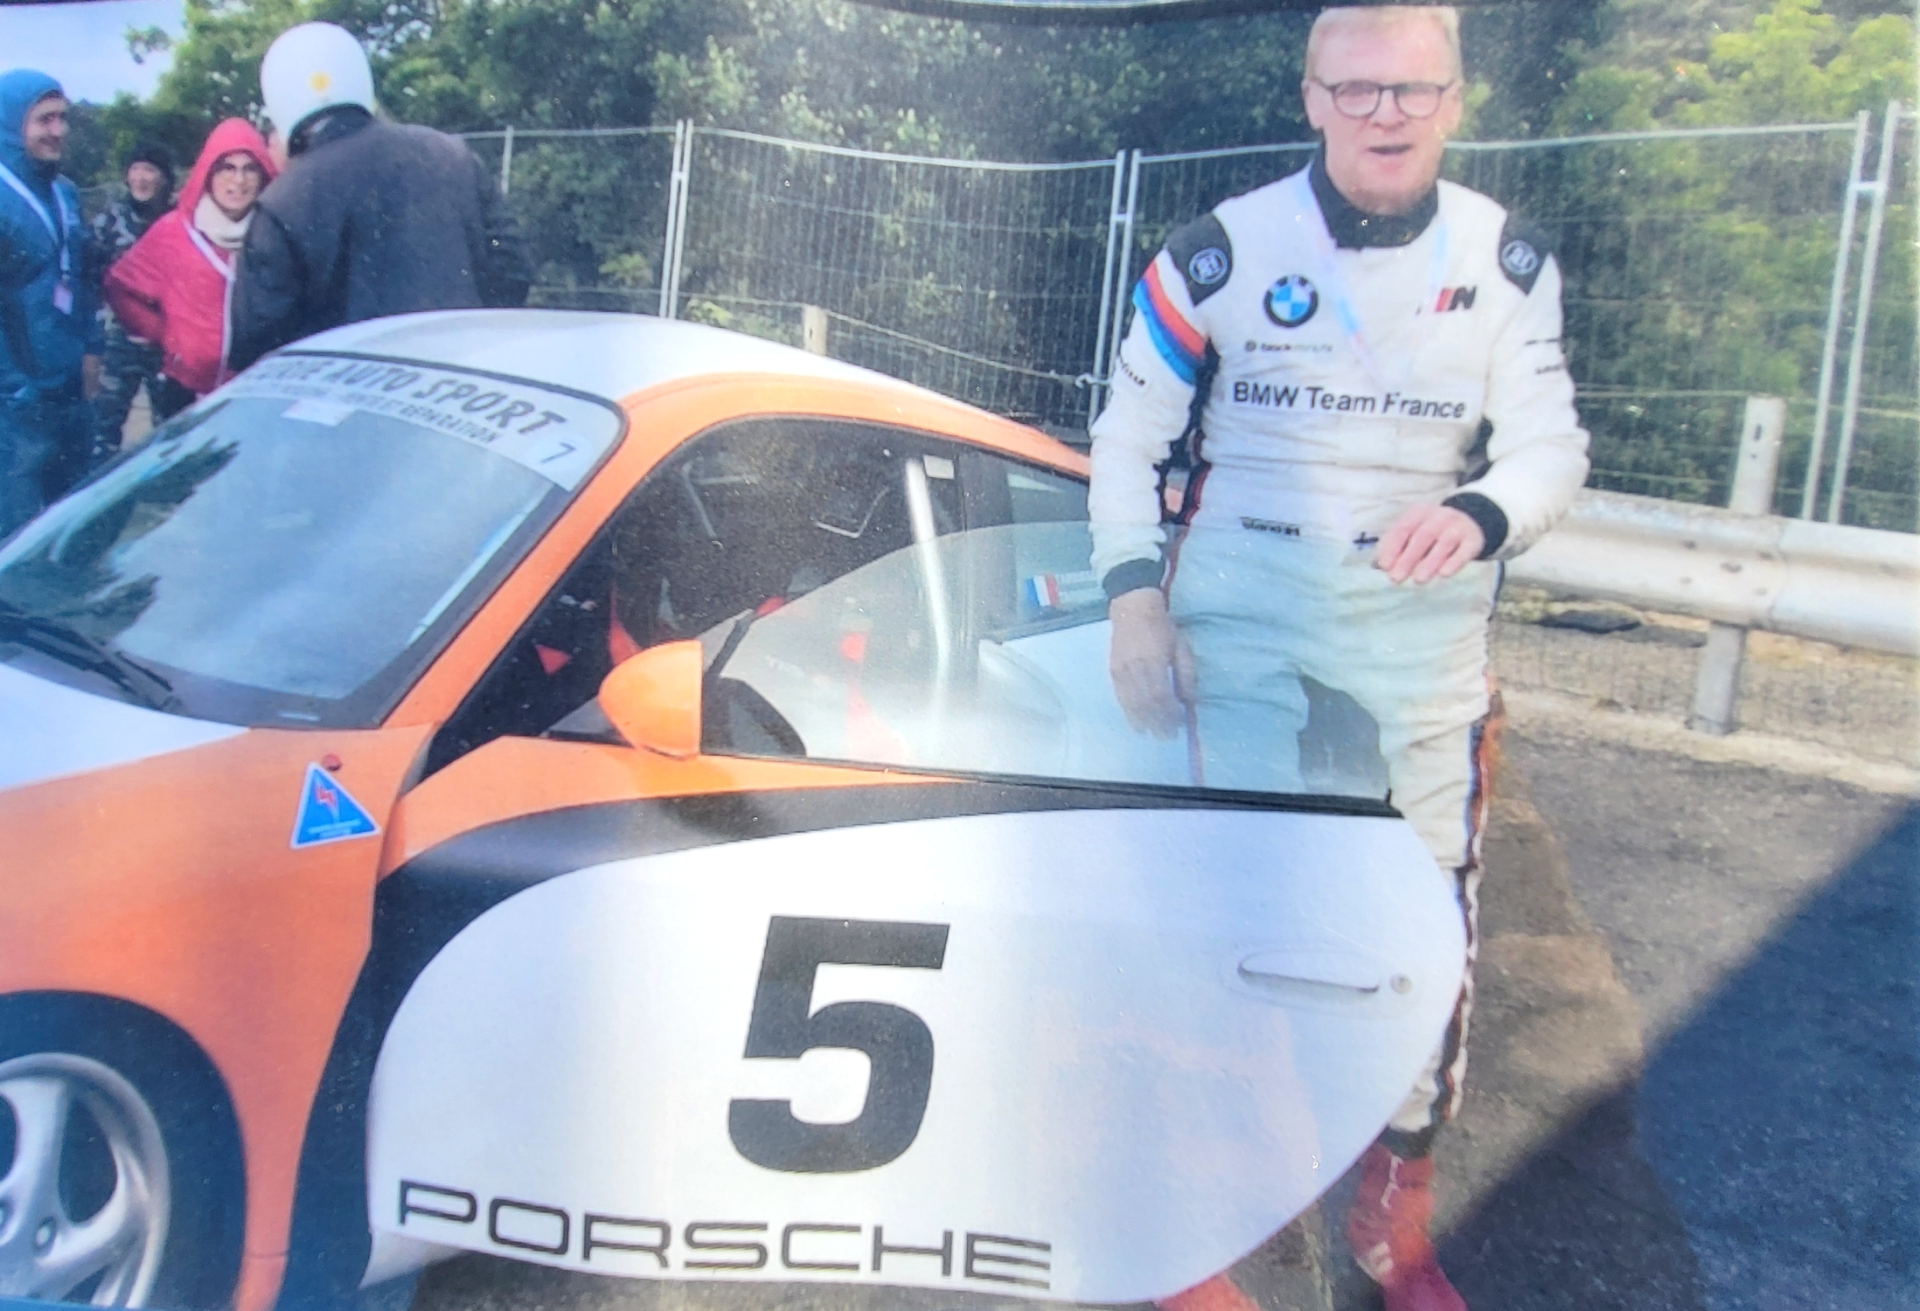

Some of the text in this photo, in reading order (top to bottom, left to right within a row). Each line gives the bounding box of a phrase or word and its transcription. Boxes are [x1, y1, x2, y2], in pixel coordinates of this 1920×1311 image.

[322, 360, 415, 392] AUTO
[411, 378, 567, 435] SPORT
[1233, 381, 1468, 419] BMW Team France
[540, 441, 578, 464] 7
[727, 914, 951, 1175] 5
[398, 1178, 1052, 1292] PORSCHE
